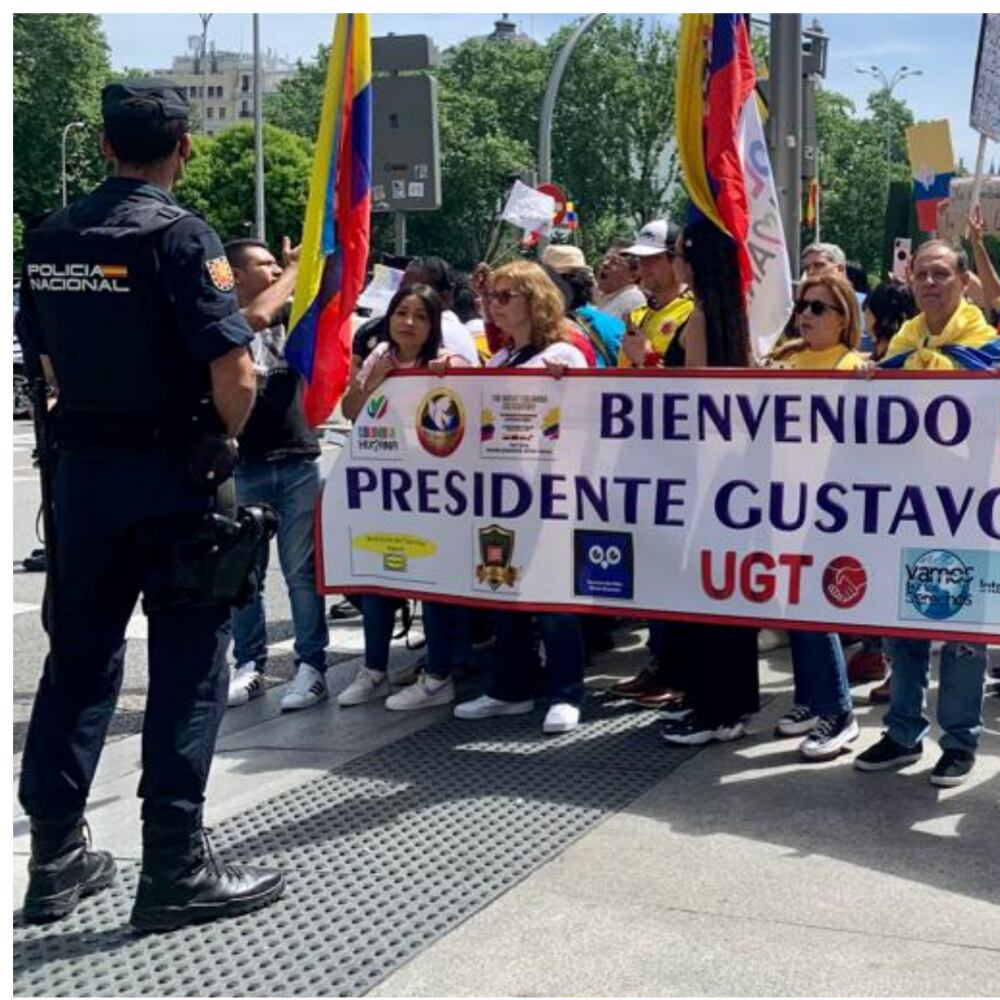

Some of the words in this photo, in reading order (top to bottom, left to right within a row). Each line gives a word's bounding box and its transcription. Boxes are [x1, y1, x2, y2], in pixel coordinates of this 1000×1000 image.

[27, 264, 104, 277] POLICIA
[30, 278, 131, 292] NACIONAL
[600, 392, 972, 447] BIENVENIDO
[345, 466, 687, 527] PRESIDENTE
[701, 549, 814, 605] UGT
